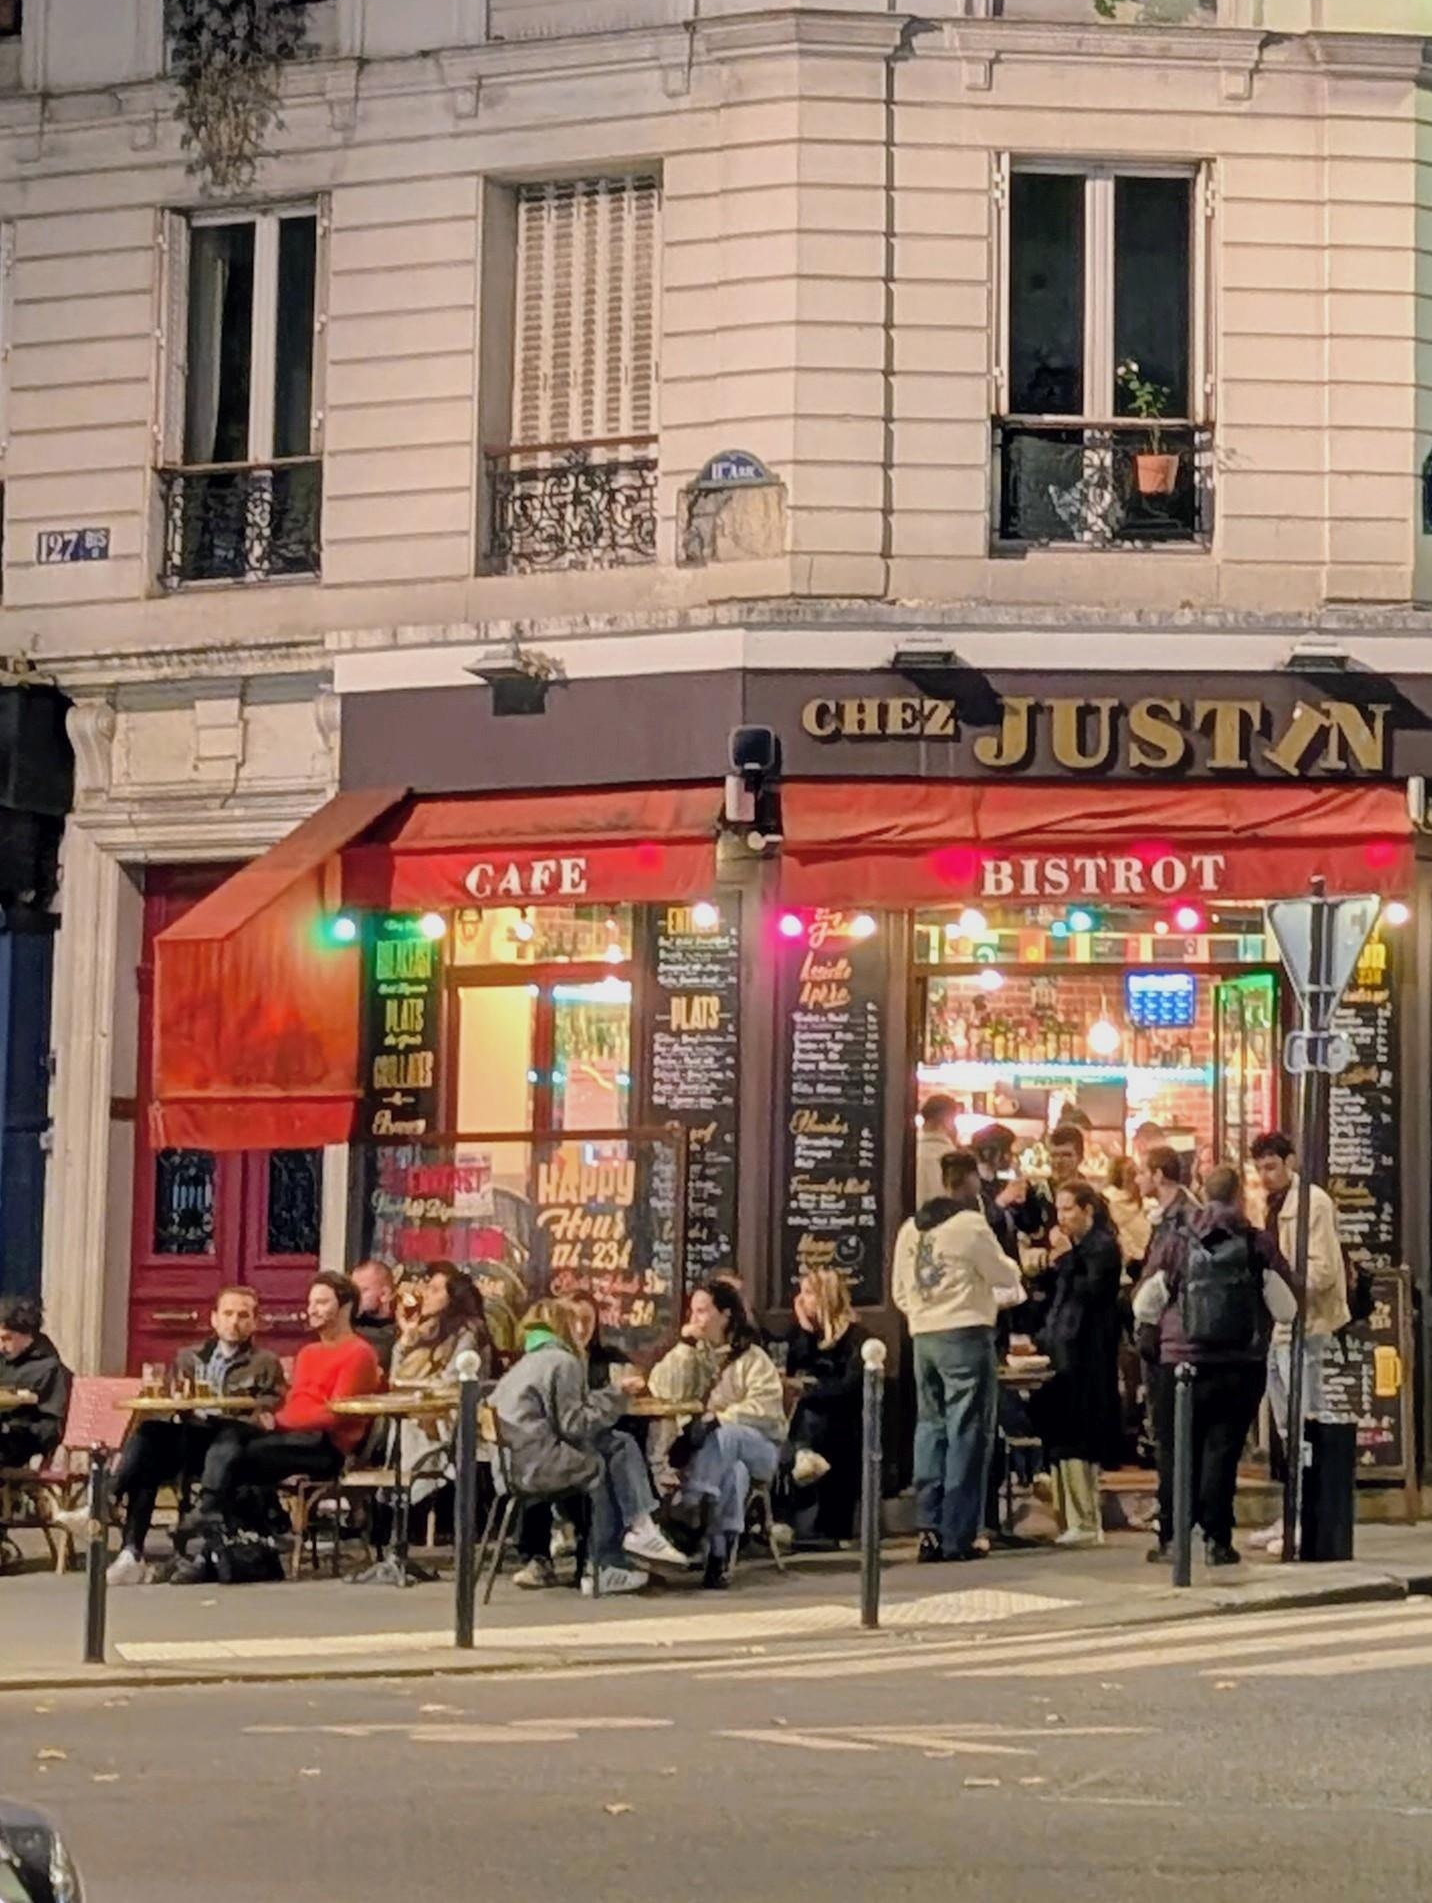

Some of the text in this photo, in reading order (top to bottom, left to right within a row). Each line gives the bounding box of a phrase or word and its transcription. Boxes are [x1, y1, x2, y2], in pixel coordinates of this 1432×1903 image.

[40, 532, 79, 562] 127
[801, 696, 1391, 776] CHEZ JUSTIN
[465, 858, 587, 898] CAFE
[980, 854, 1225, 896] BISTROT
[385, 998, 424, 1032] PLATS
[671, 996, 720, 1031] PLATS
[538, 1158, 635, 1206] HAPPY
[537, 1208, 624, 1240] Hour
